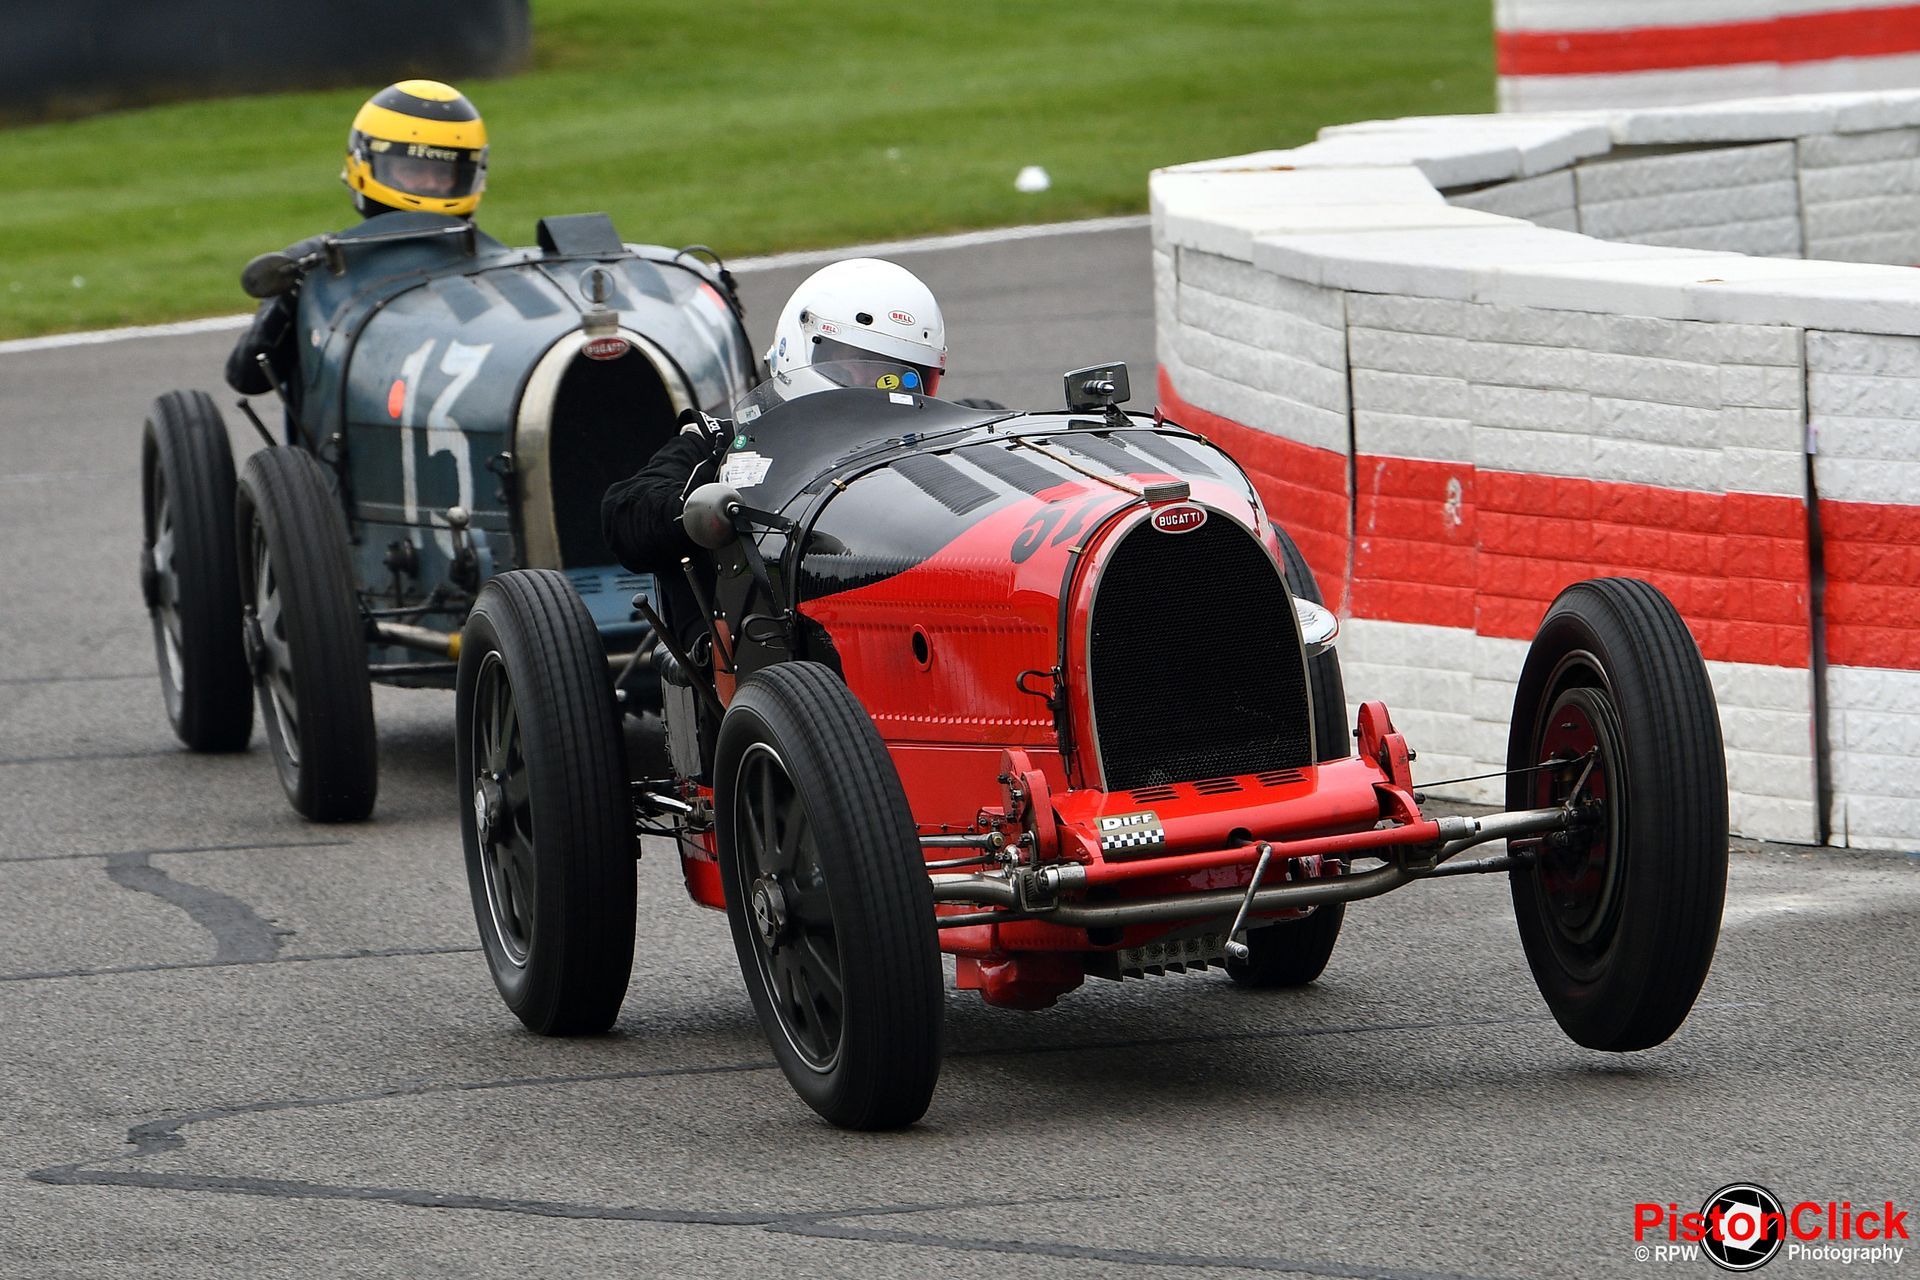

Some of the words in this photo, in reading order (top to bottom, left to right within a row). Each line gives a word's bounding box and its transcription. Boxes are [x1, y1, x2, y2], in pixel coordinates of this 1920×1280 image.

[892, 312, 912, 323] BELL
[822, 324, 836, 334] BELL
[883, 376, 892, 386] E
[402, 339, 494, 560] 13
[1159, 512, 1201, 527] BUGATTI
[1101, 813, 1153, 831] DIFF
